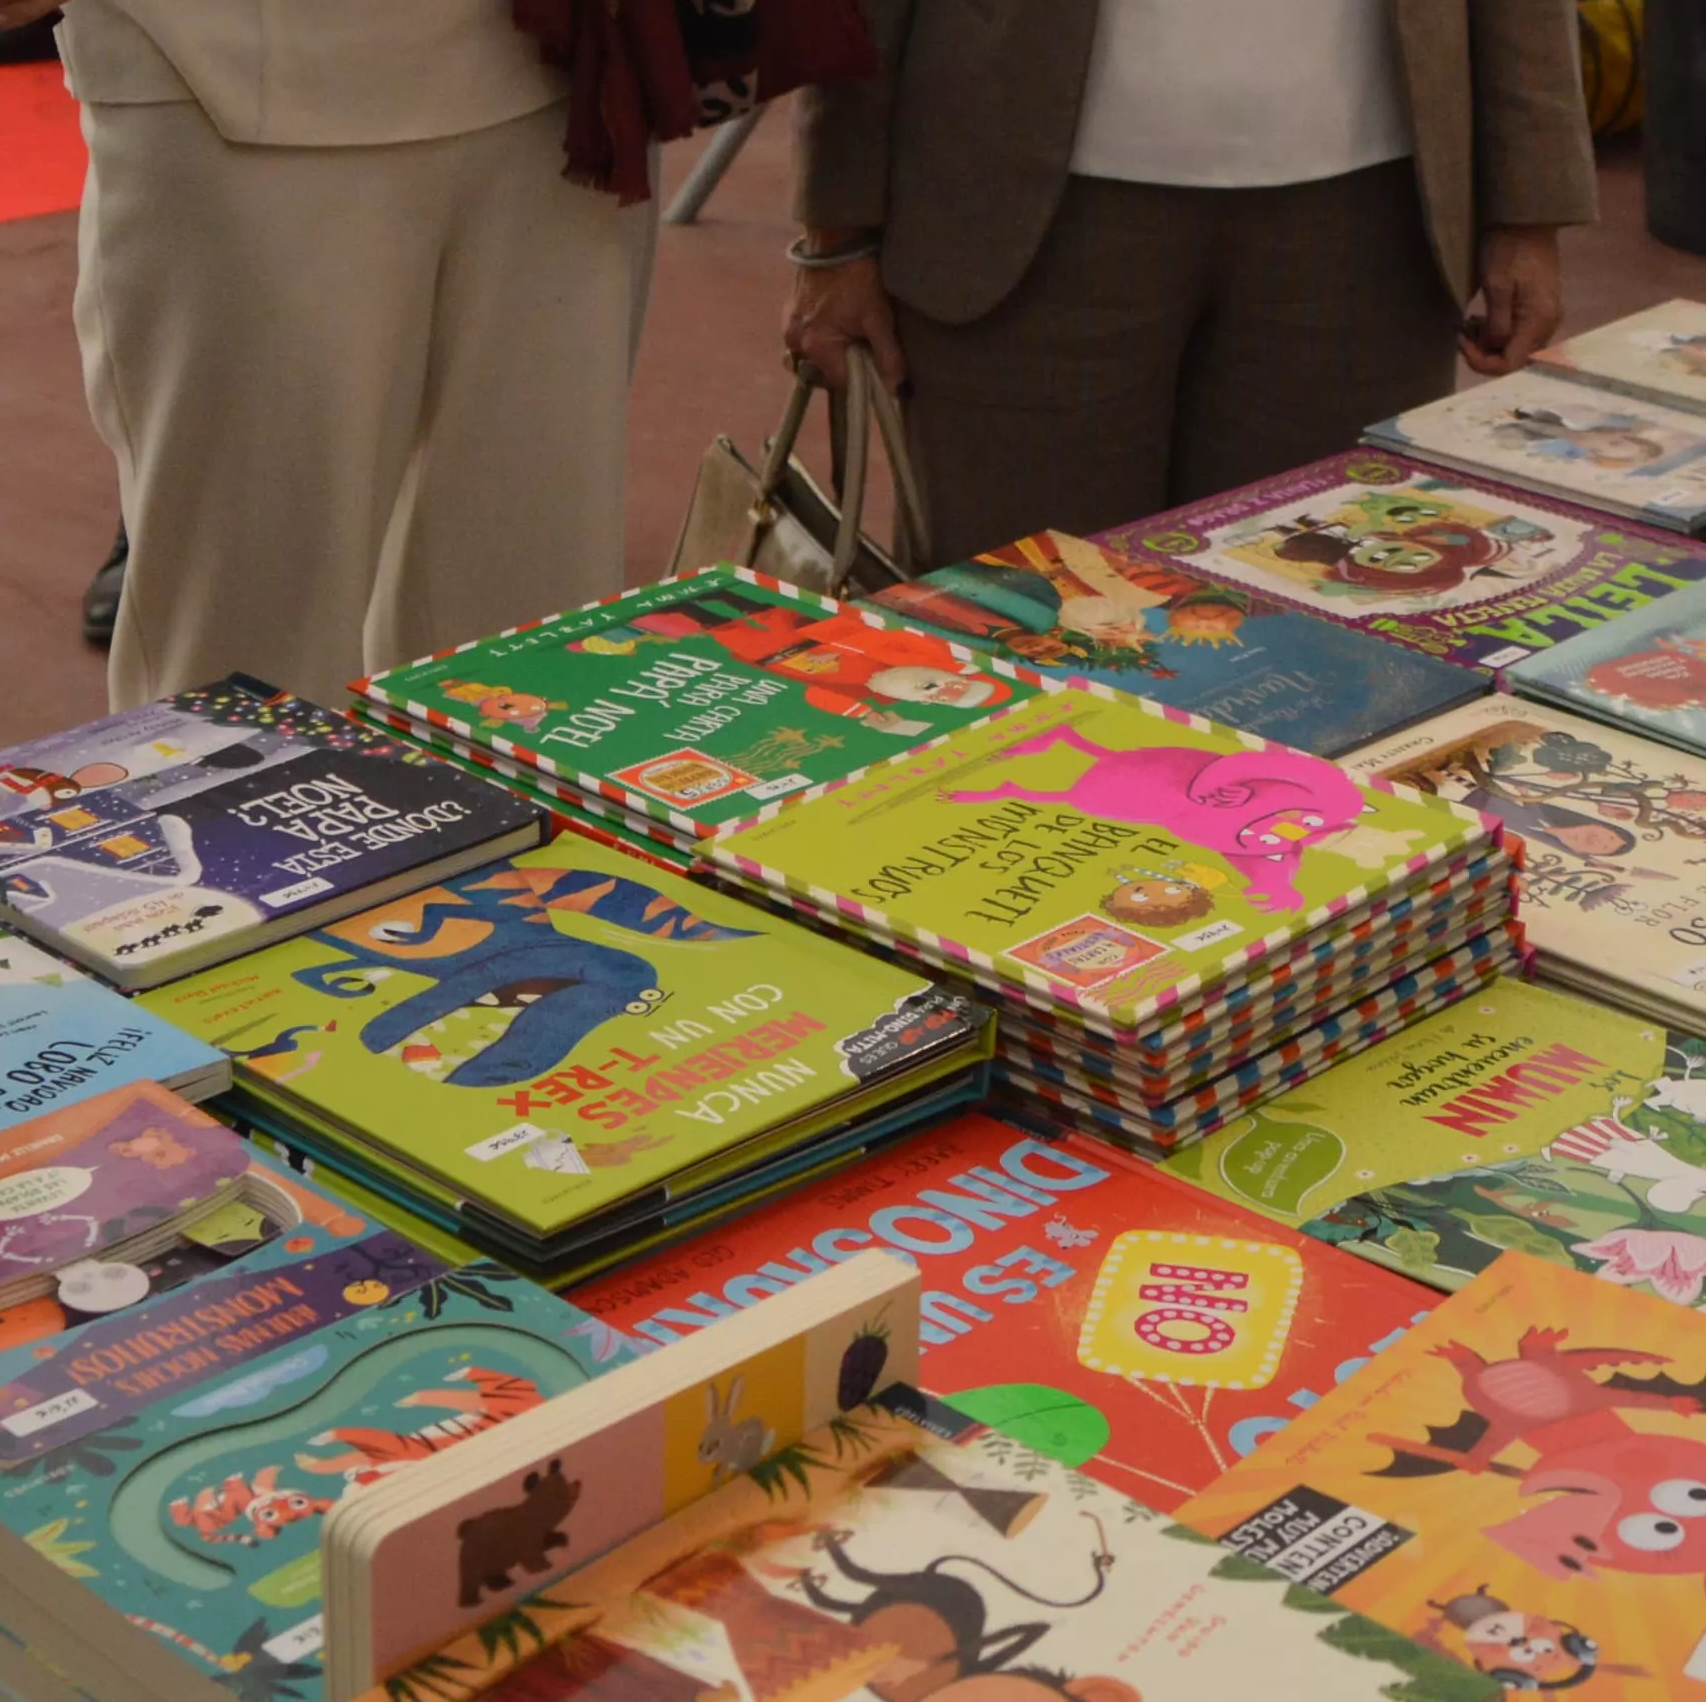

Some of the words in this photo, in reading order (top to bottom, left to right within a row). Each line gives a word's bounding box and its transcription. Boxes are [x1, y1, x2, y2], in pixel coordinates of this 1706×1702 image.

[1470, 562, 1695, 648] LEILA
[608, 652, 724, 709] PAPÁ
[677, 673, 752, 707] PARA
[733, 679, 789, 706] UNA
[539, 698, 637, 748] NOEL
[663, 705, 742, 742] CARTA
[227, 772, 365, 827] NOEL?
[273, 795, 401, 844] PAPÁ
[350, 800, 473, 851] ¿DÓNDE
[1048, 812, 1085, 838] DE
[1131, 837, 1182, 856] EL
[272, 843, 364, 878] ESTÁ
[850, 801, 1045, 905] MONSTRUOS
[964, 821, 1141, 927] BANQUETE
[992, 836, 1041, 874] LOS
[1631, 891, 1690, 929] FLOR
[706, 983, 785, 1026] CON
[95, 1027, 155, 1068] ¡FELIZ
[647, 1018, 716, 1051] UN
[843, 1009, 921, 1057] DINO-MITA
[1453, 1032, 1500, 1055] su
[5, 1039, 95, 1087] LOBO
[496, 1047, 662, 1118] T-REX
[577, 1010, 828, 1132] MERIENDES
[1385, 1048, 1453, 1093] hogar
[1397, 1034, 1536, 1110] encuentran
[675, 1058, 817, 1126] NUNCA
[1421, 1042, 1612, 1140] MUMIN
[963, 1241, 1076, 1309] ES
[1133, 1262, 1250, 1355] NO
[1281, 1509, 1320, 1547] MUY
